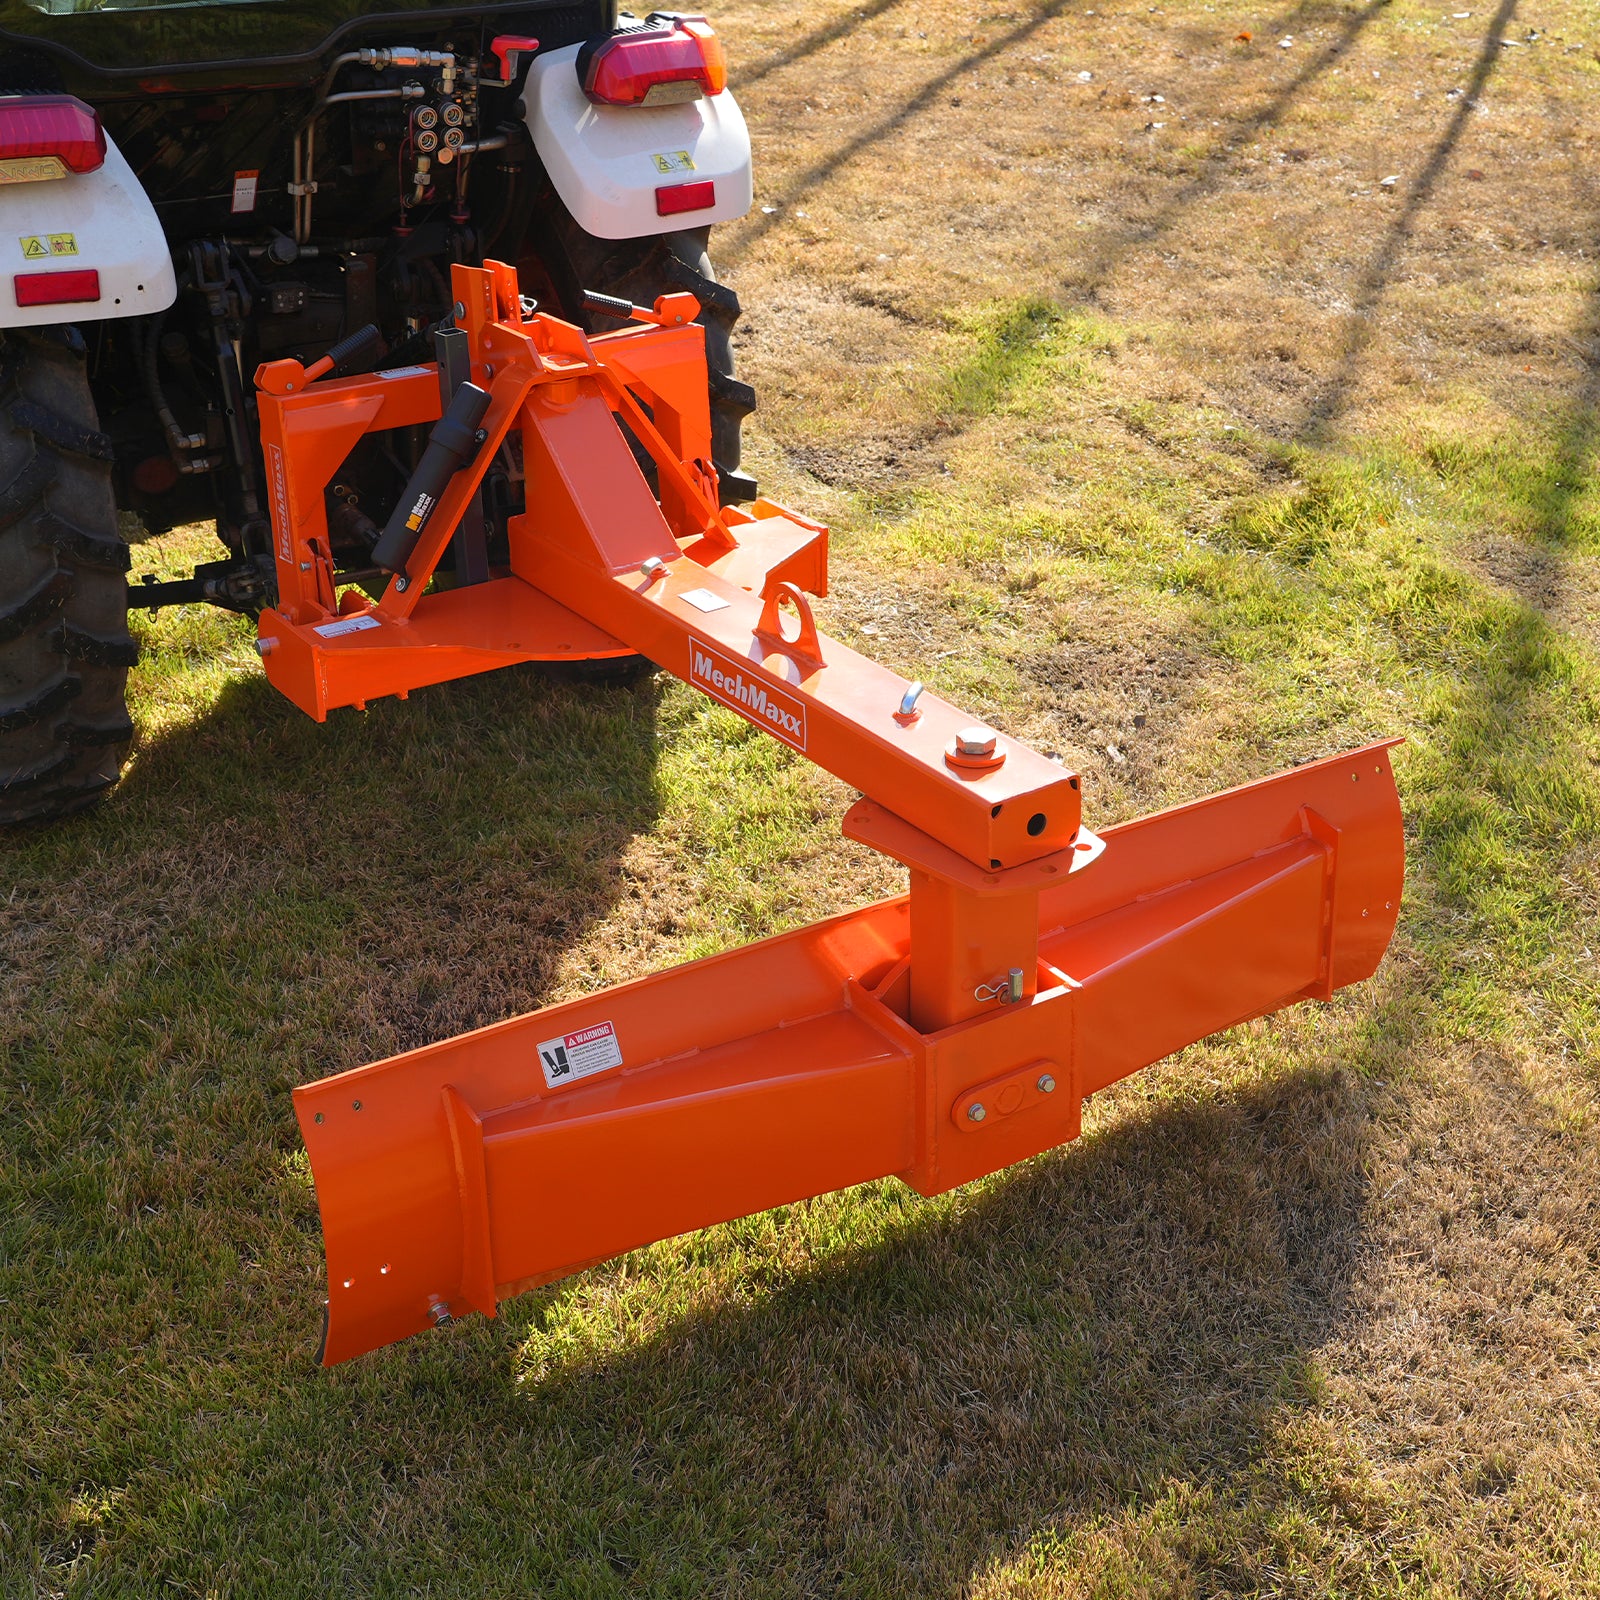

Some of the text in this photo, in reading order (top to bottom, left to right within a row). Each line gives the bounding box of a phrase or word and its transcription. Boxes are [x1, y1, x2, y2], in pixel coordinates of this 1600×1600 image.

[274, 450, 290, 559] MechMaxx
[411, 492, 427, 514] Mech
[417, 496, 432, 517] Maxx
[694, 651, 801, 737] MechMaxx
[575, 1025, 610, 1043] WARNING
